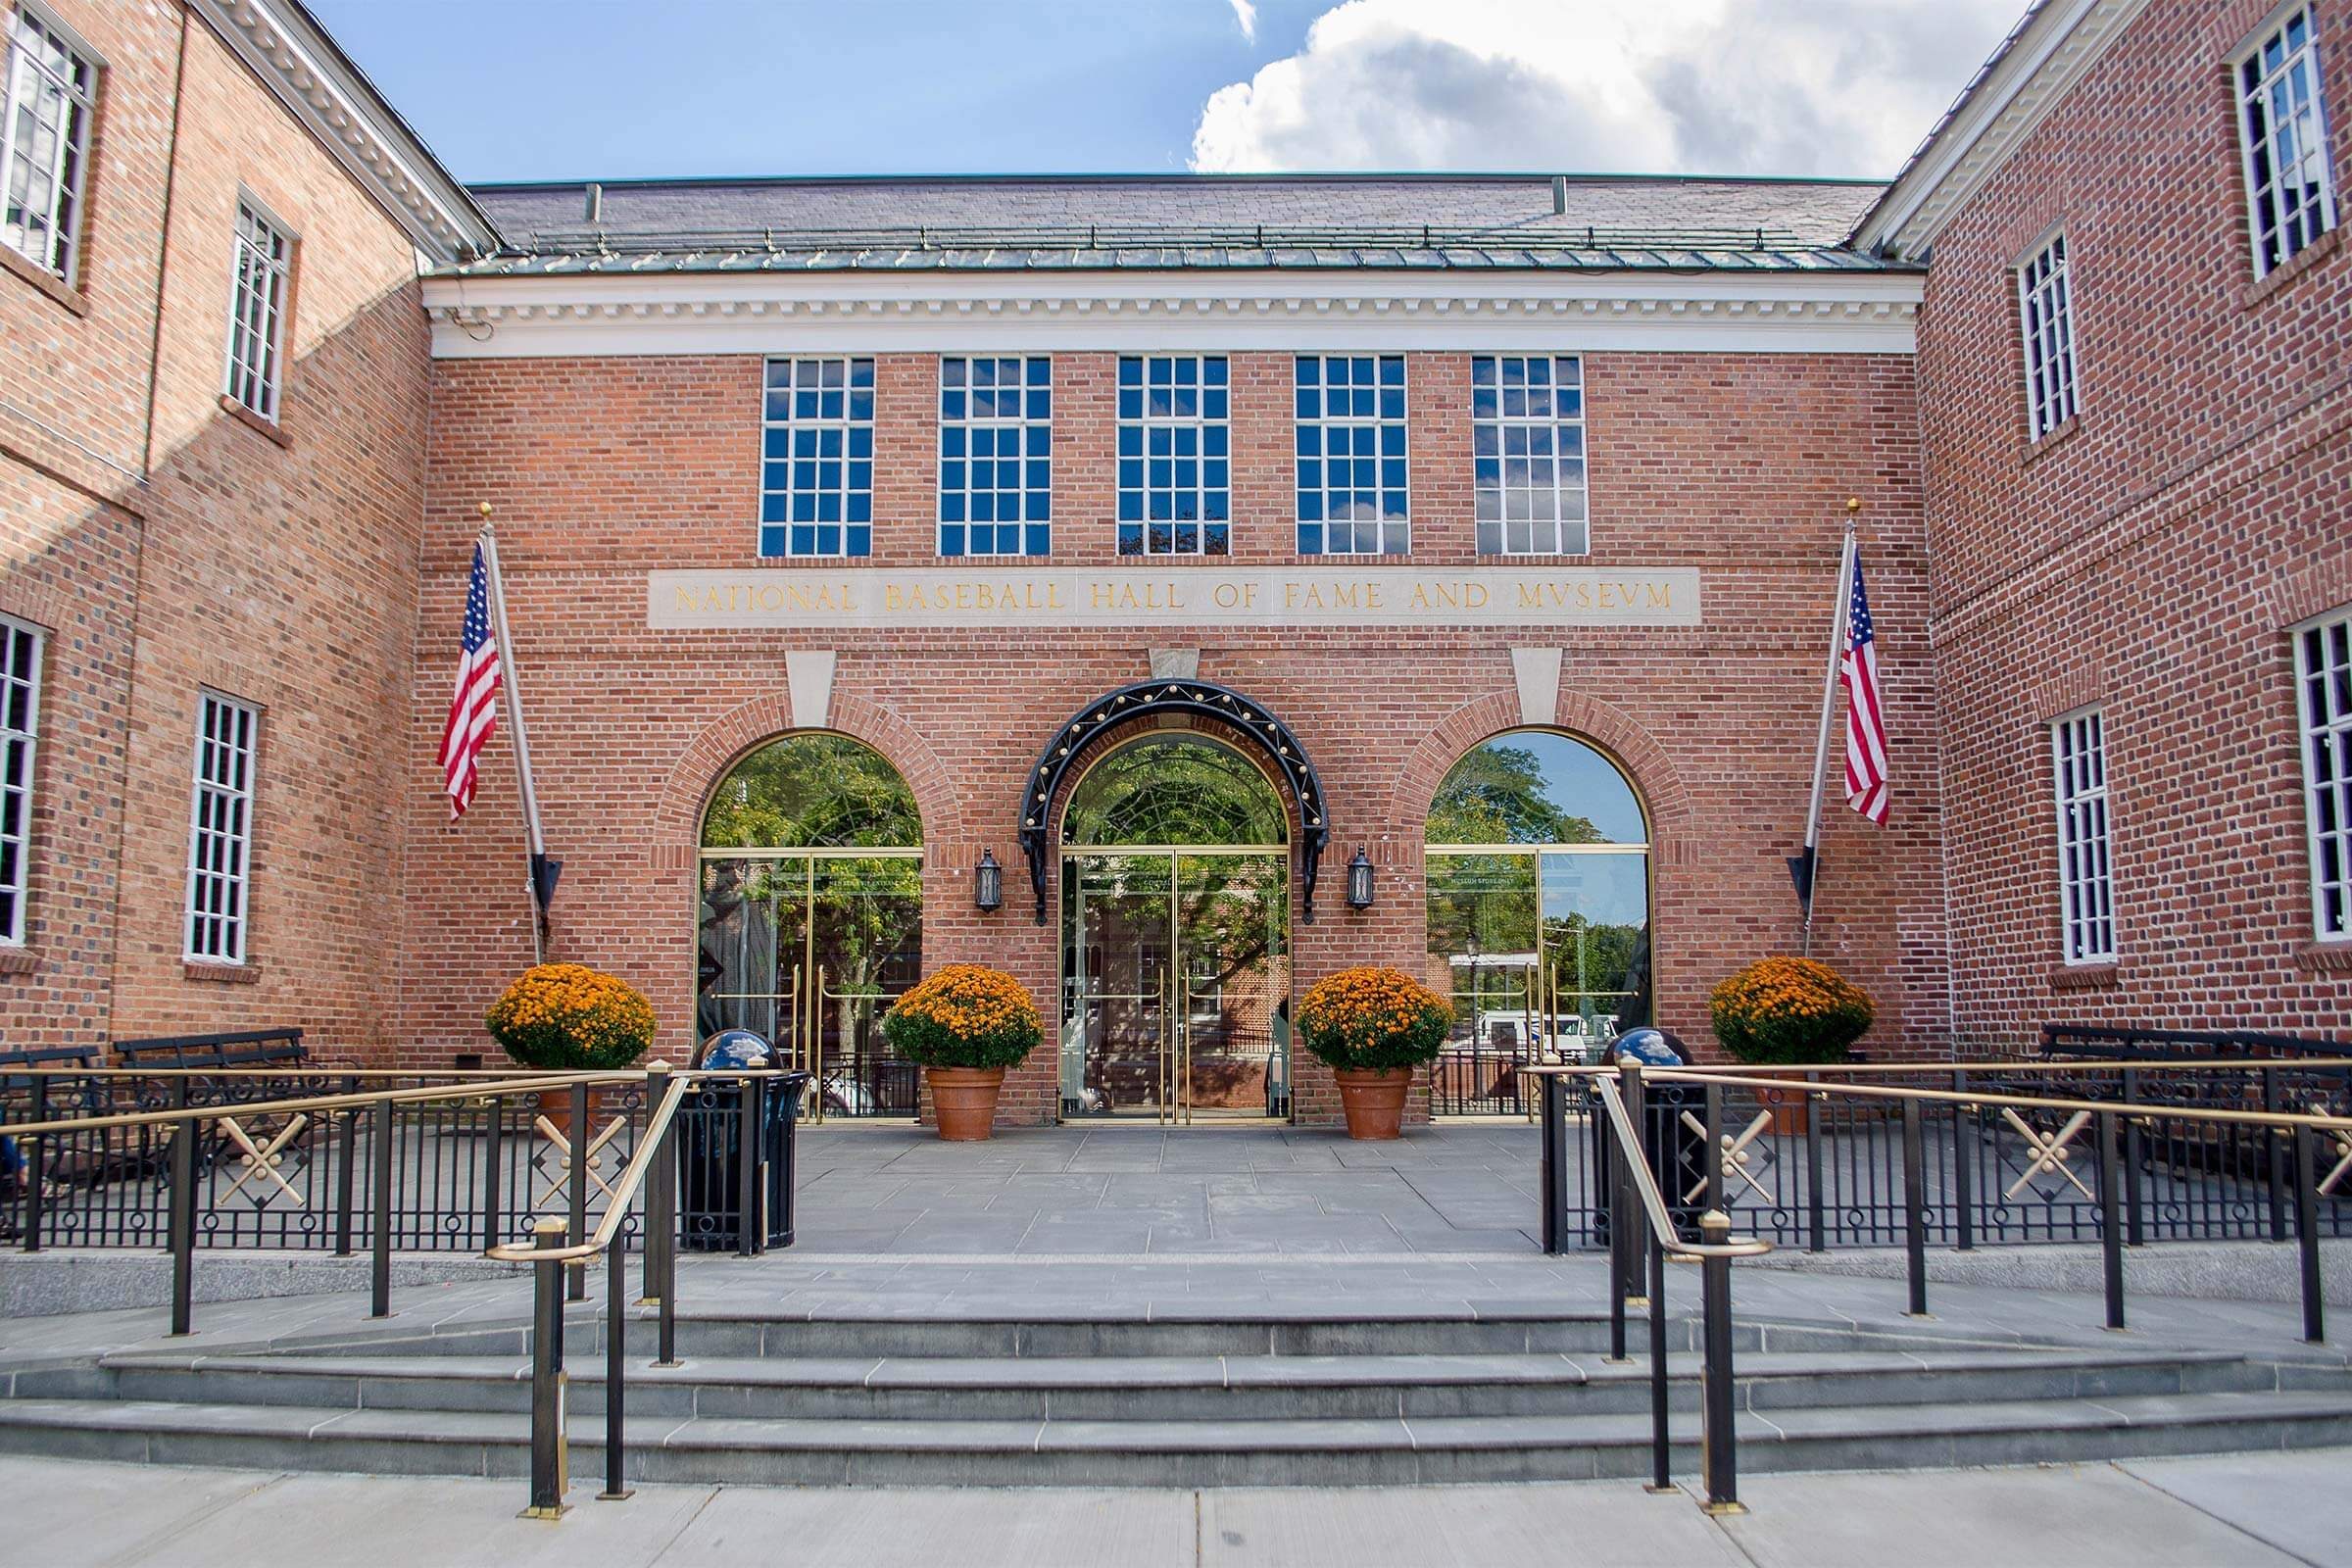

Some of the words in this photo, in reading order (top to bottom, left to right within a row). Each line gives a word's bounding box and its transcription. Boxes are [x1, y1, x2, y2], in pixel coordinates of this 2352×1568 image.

[675, 584, 858, 612] NATIONAL
[885, 583, 1065, 612] BASEBALL
[1092, 583, 1185, 611] HALL
[1214, 583, 1258, 609] OF
[1284, 582, 1384, 609] FAME
[1409, 582, 1491, 609] AND
[1517, 582, 1672, 609] MVSEVM
